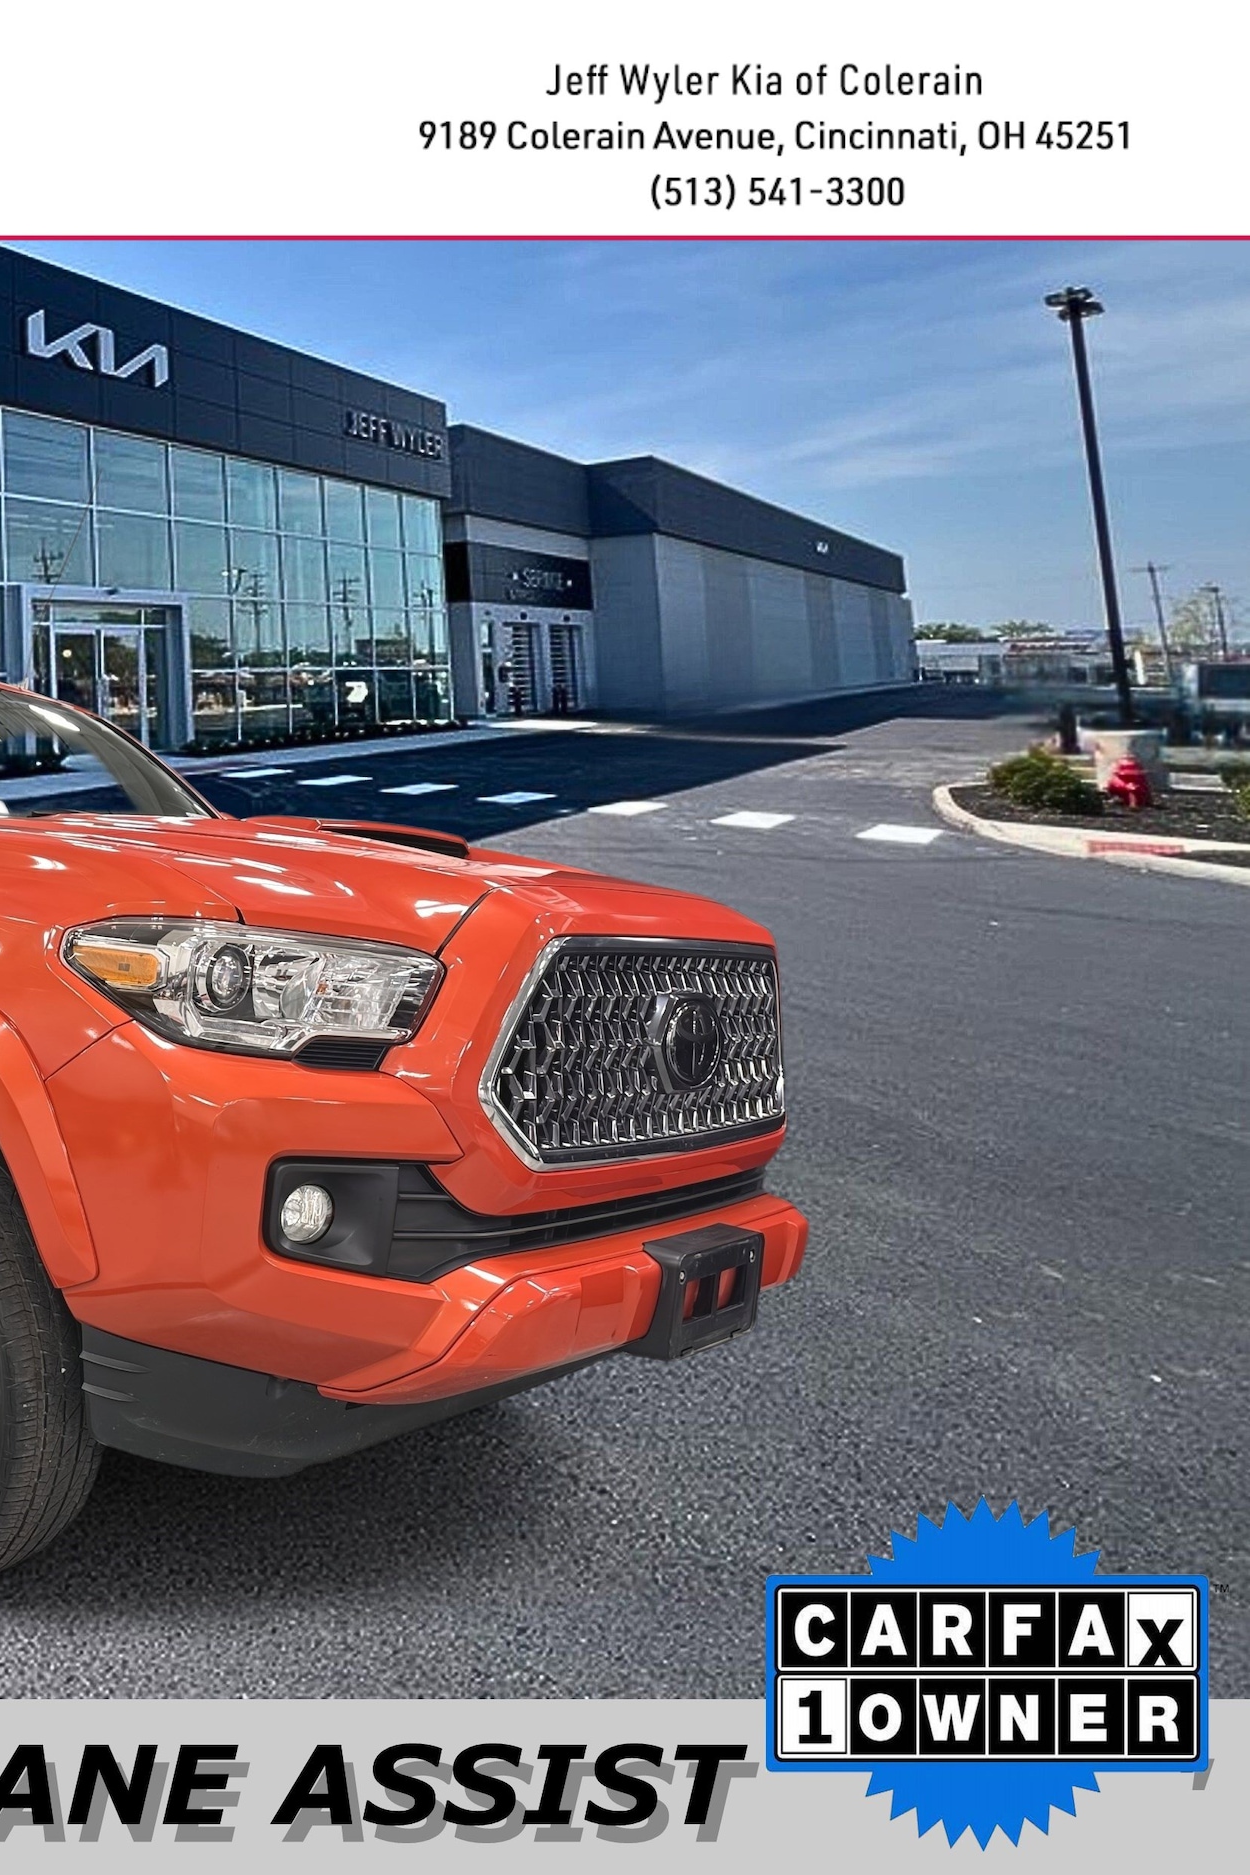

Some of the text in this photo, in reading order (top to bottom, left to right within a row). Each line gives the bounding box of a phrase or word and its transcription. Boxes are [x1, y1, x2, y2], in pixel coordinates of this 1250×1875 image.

[28, 309, 169, 388] KIA
[348, 412, 443, 458] JEFF WYLER
[522, 568, 563, 591] SERIE
